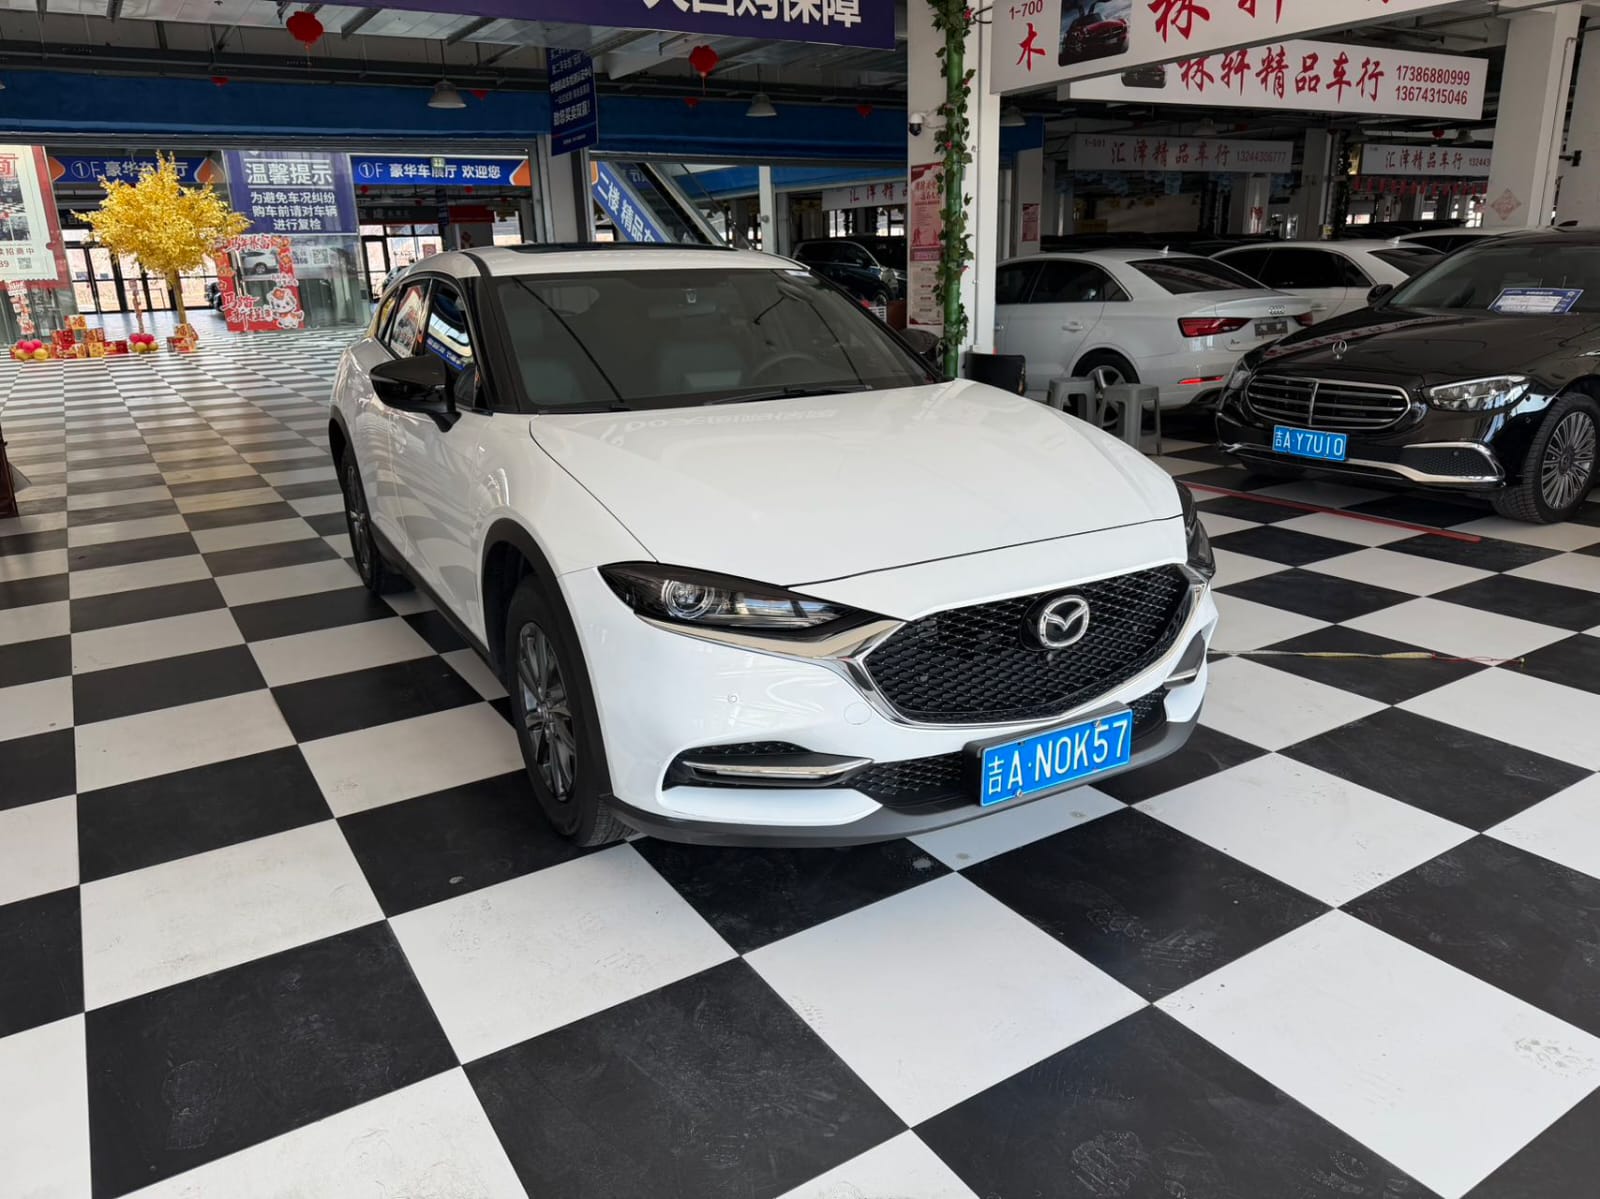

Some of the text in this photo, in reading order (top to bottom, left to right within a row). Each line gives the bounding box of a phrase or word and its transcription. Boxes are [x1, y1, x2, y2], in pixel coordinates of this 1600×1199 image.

[1009, 0, 1043, 20] 1-700
[1396, 65, 1470, 86] 17386880999
[1395, 86, 1468, 105] 13674315046
[245, 163, 333, 185] 温馨提示
[461, 165, 502, 179] 欢迎您
[250, 191, 336, 204] 为避免车况纠纷
[252, 205, 338, 217] 购车前请对车辆
[273, 218, 322, 231] 进行复检
